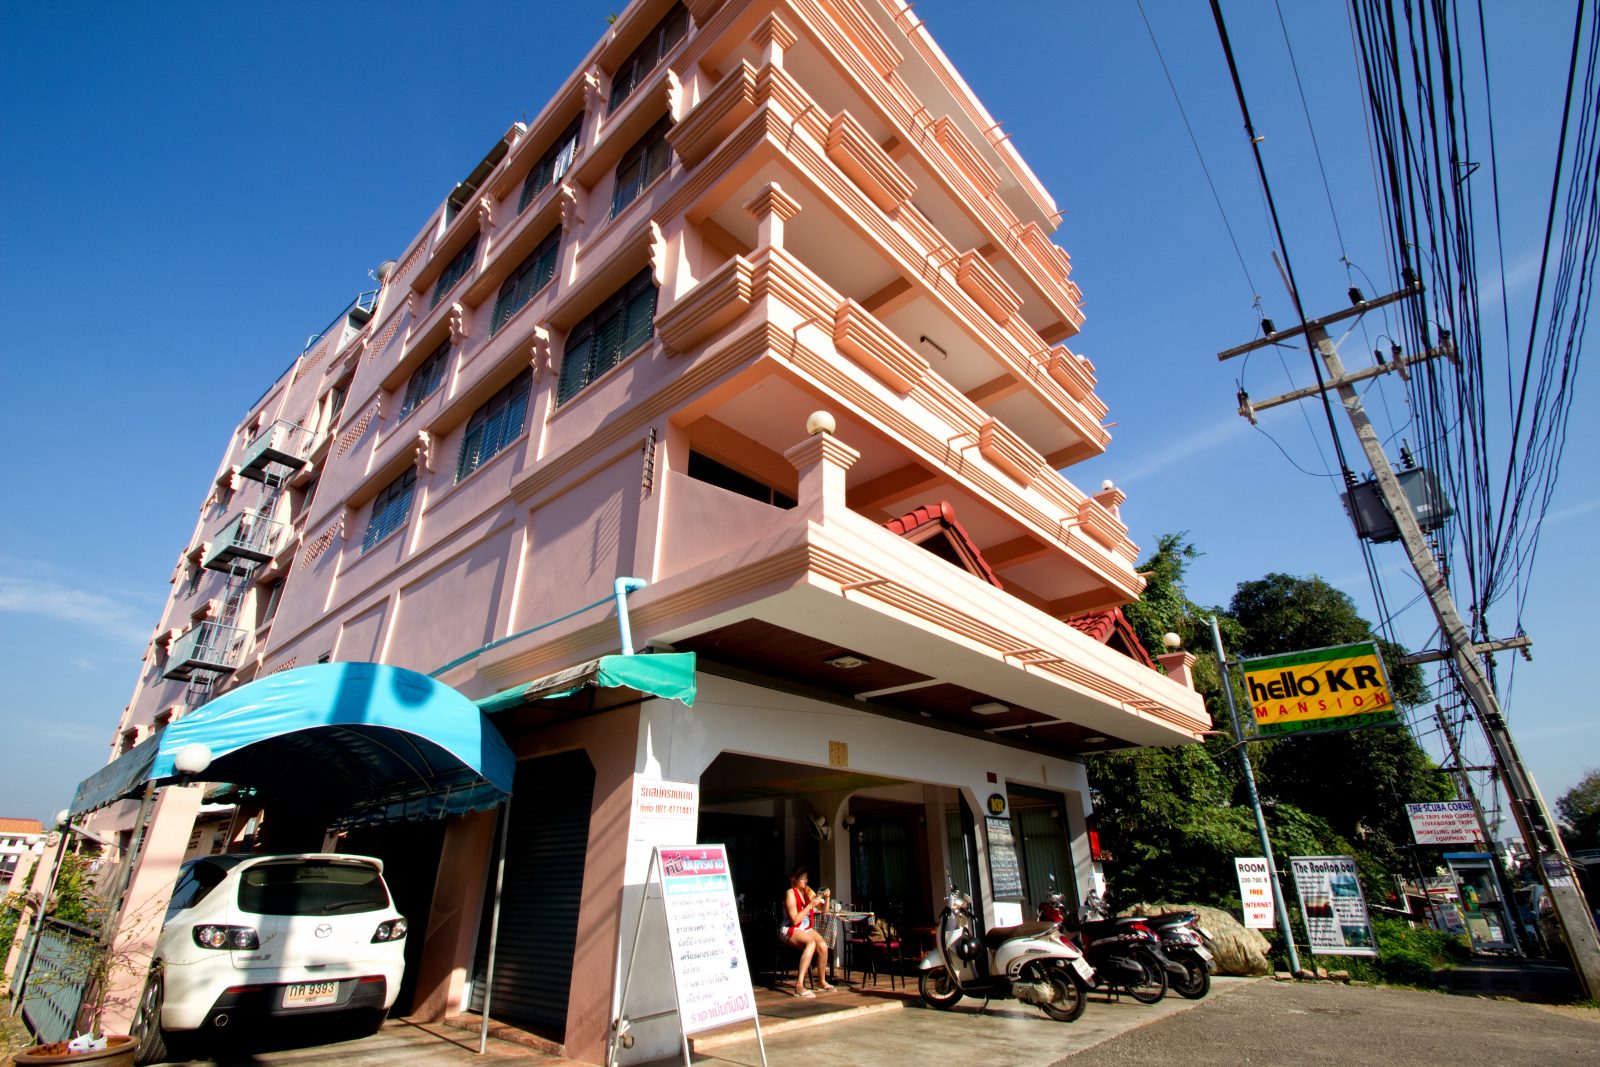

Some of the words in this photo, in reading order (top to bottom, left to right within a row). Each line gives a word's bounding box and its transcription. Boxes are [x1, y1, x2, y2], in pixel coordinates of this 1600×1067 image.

[1248, 671, 1320, 702] hello
[1325, 665, 1382, 693] KR
[1255, 692, 1386, 718] MANSION
[991, 798, 1004, 812] KR
[1408, 804, 1422, 813] THE
[1424, 803, 1447, 812] SCUBA
[1447, 802, 1473, 811] CORNE
[1238, 863, 1266, 873] ROOM
[1294, 862, 1308, 873] The
[1309, 861, 1339, 875] Rooftop
[1340, 862, 1355, 873] bar
[309, 981, 335, 995] 9393
